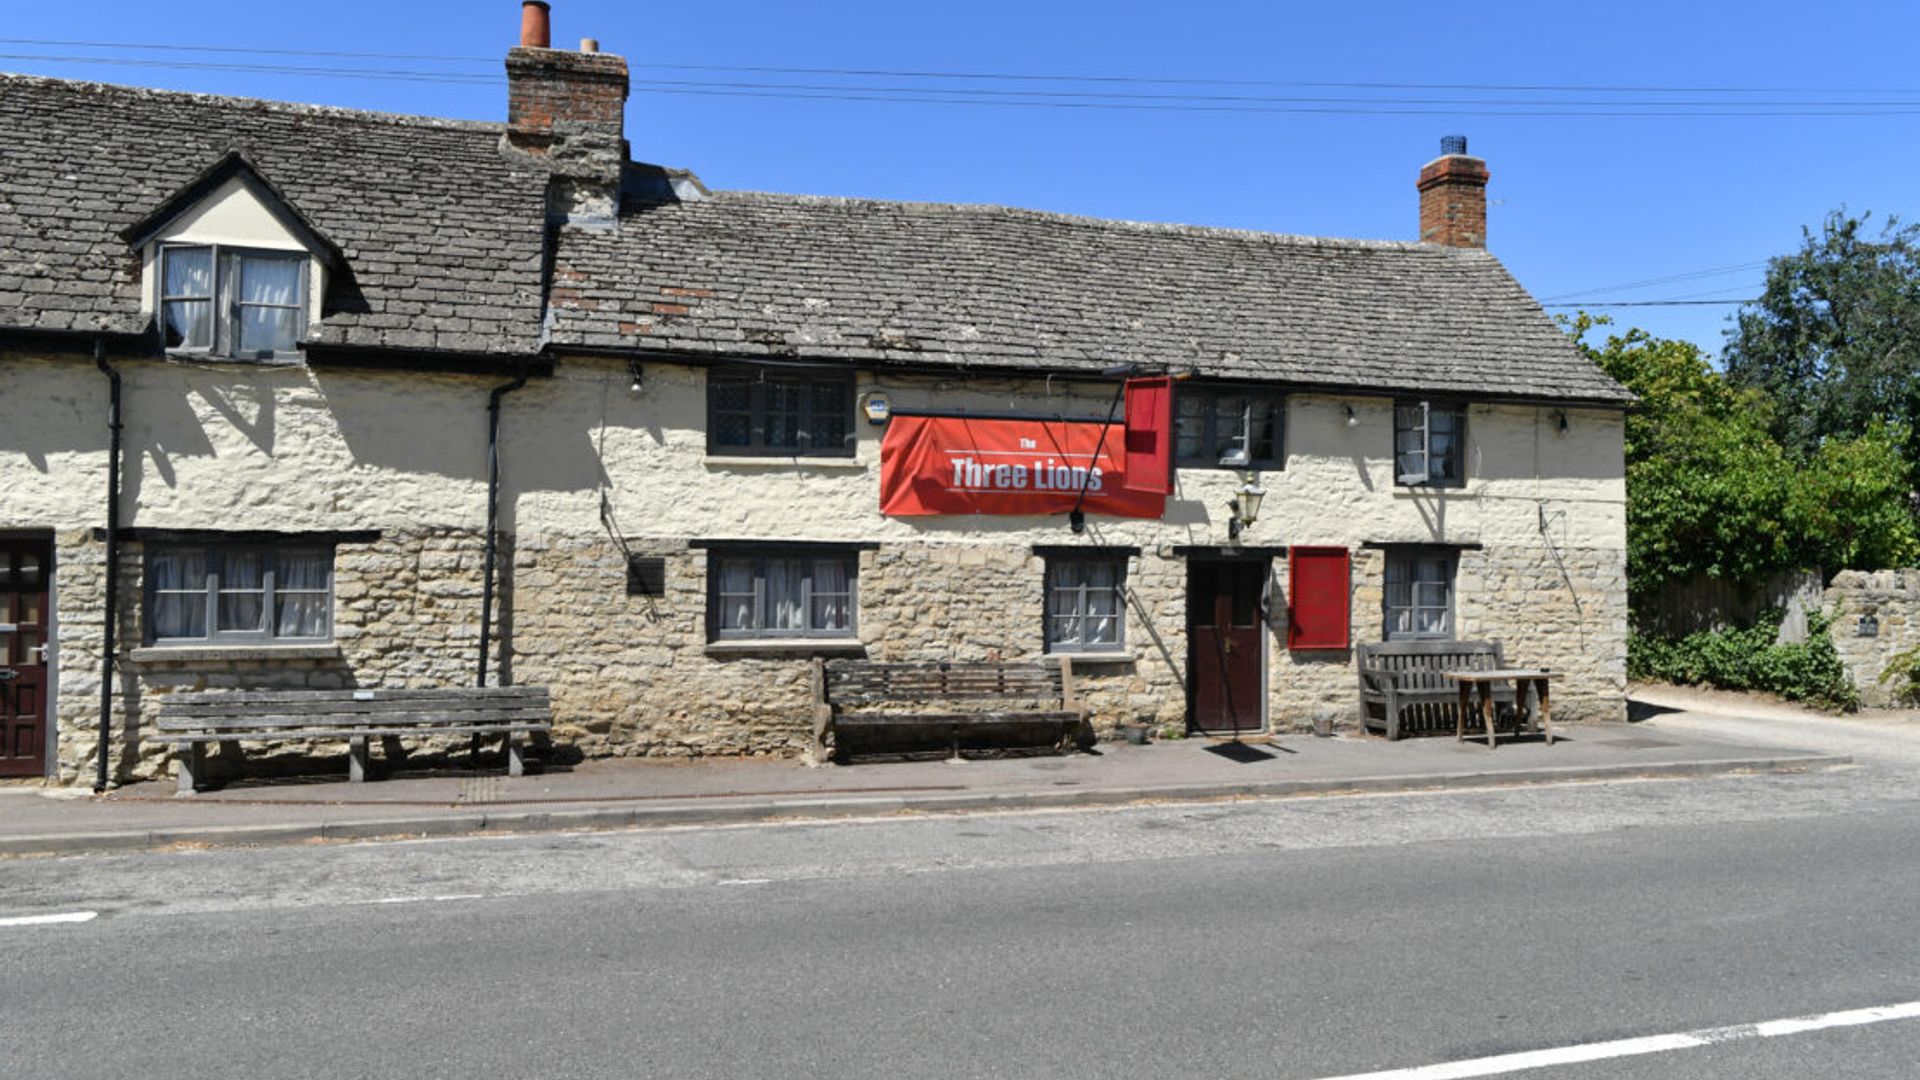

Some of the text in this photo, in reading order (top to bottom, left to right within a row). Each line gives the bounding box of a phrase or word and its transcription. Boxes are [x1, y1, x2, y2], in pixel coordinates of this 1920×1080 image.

[1020, 438, 1036, 449] The
[951, 457, 1103, 490] Three Lions
